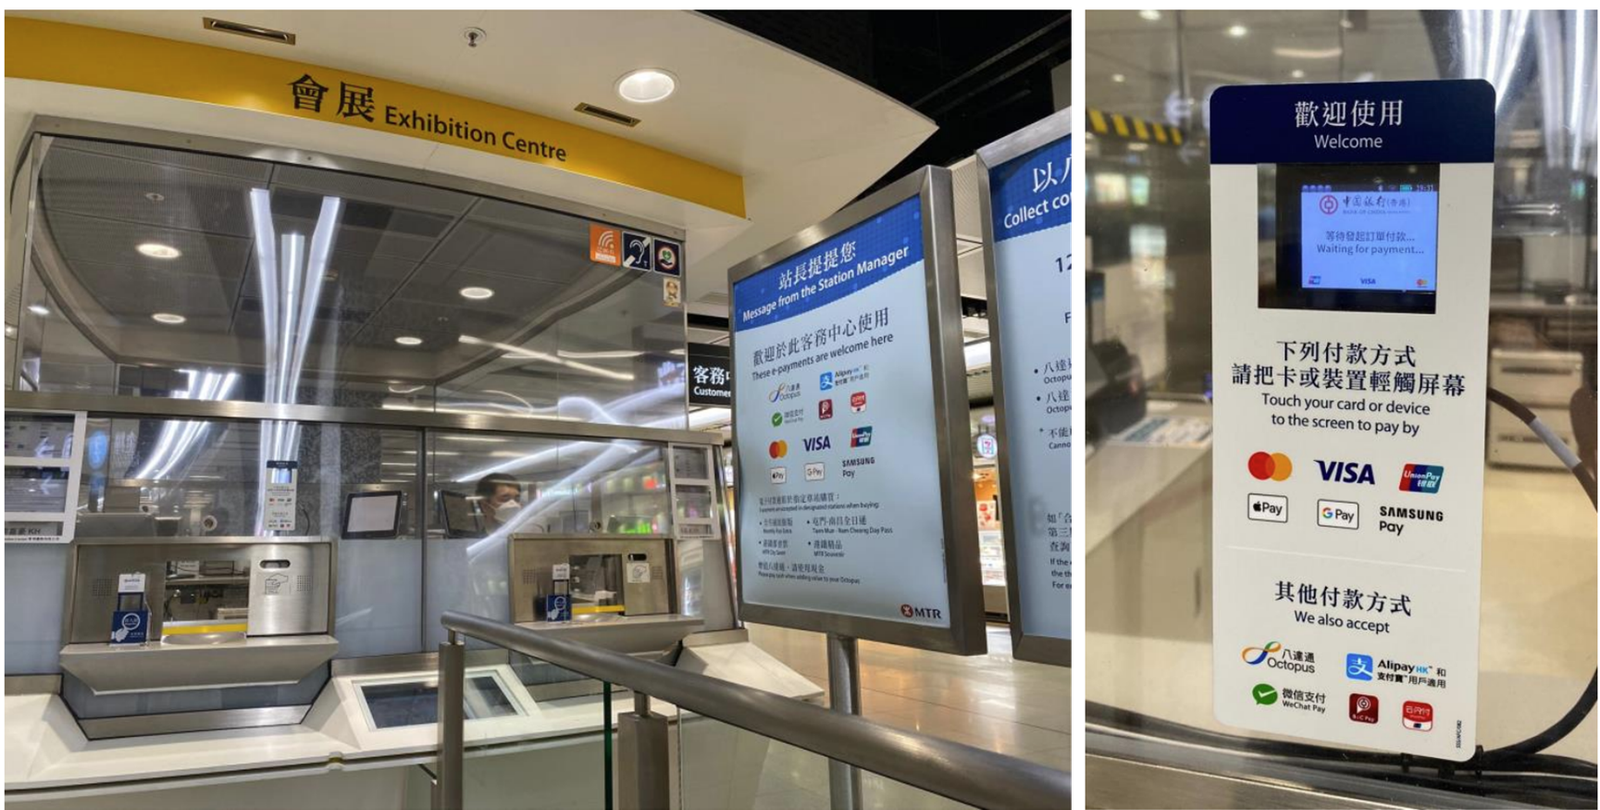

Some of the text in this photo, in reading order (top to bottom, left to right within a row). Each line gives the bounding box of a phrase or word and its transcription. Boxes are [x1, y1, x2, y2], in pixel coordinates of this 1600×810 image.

[287, 74, 567, 162] 會展 Exhibition Centre
[1294, 99, 1403, 128] 歡迎使用
[1314, 134, 1383, 149] Welcome
[1004, 199, 1049, 229] Collect
[1317, 243, 1424, 256] Waiting for payment...
[778, 241, 857, 290] 站長提提您
[743, 246, 909, 322] Message from the Station Manager
[752, 332, 893, 381] These e-payments are welcome here
[1276, 340, 1417, 368] 下列付款方式
[1231, 362, 1466, 397] 請把卡或裝置輕觸屏幕
[1261, 392, 1431, 415] Touch your card or device
[1271, 414, 1420, 438] to the screen to pay by
[803, 435, 831, 452] VISA
[842, 457, 875, 468] SAMSUNG
[842, 469, 855, 478] Pay
[1313, 459, 1376, 485] VISA
[1404, 470, 1440, 482] UnionPay
[1261, 501, 1283, 516] Pay
[1335, 508, 1355, 523] Pay
[1380, 505, 1444, 522] SAMSUNG
[1379, 520, 1404, 537] Pay
[1052, 581, 1064, 589] For
[1275, 579, 1412, 617] 其他付款方式
[915, 607, 942, 619] MTR
[1294, 610, 1390, 635] We also accept
[1282, 648, 1315, 663] 八達通
[1267, 657, 1316, 674] Octopus
[1282, 688, 1326, 704] 微信支付
[1282, 700, 1326, 714] WeChat Pay
